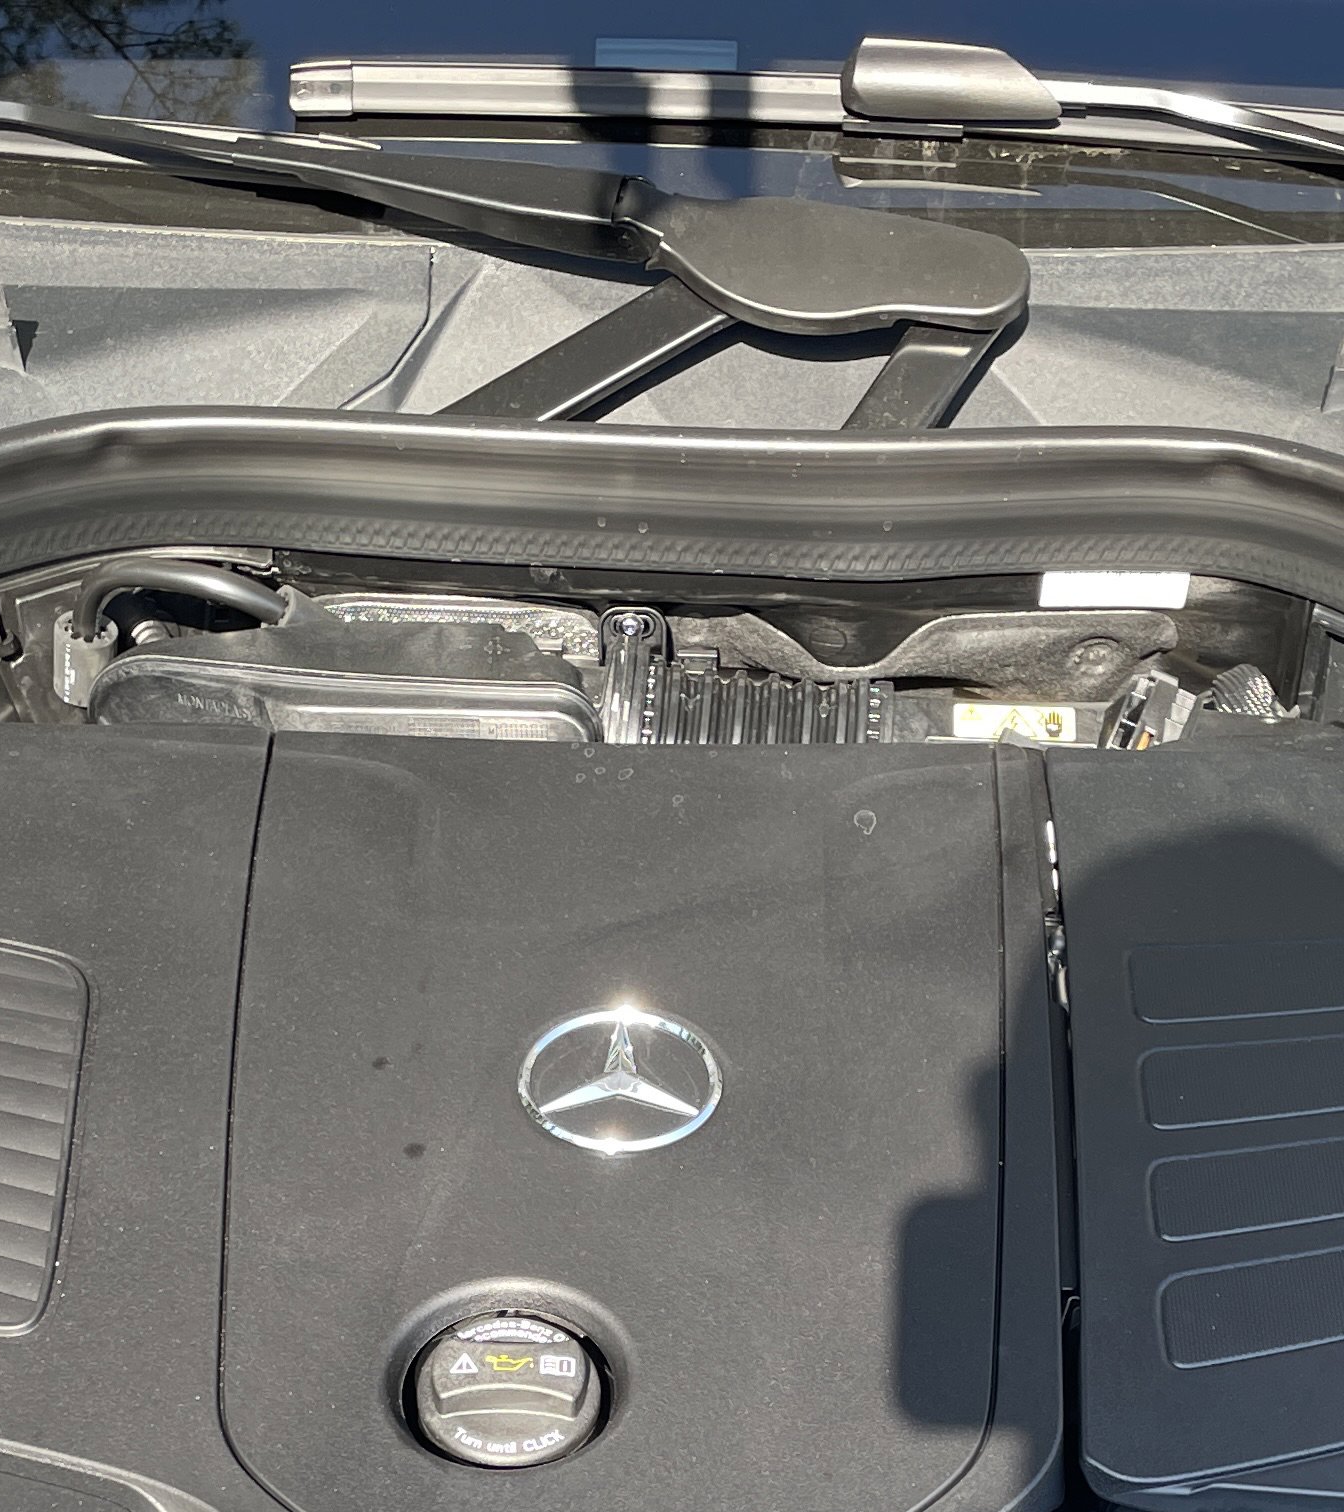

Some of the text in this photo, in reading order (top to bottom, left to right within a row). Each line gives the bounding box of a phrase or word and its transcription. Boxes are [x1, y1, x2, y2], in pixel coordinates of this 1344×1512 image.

[473, 1329, 553, 1343] ecommende
[455, 1426, 565, 1454] Turn until CLICK
